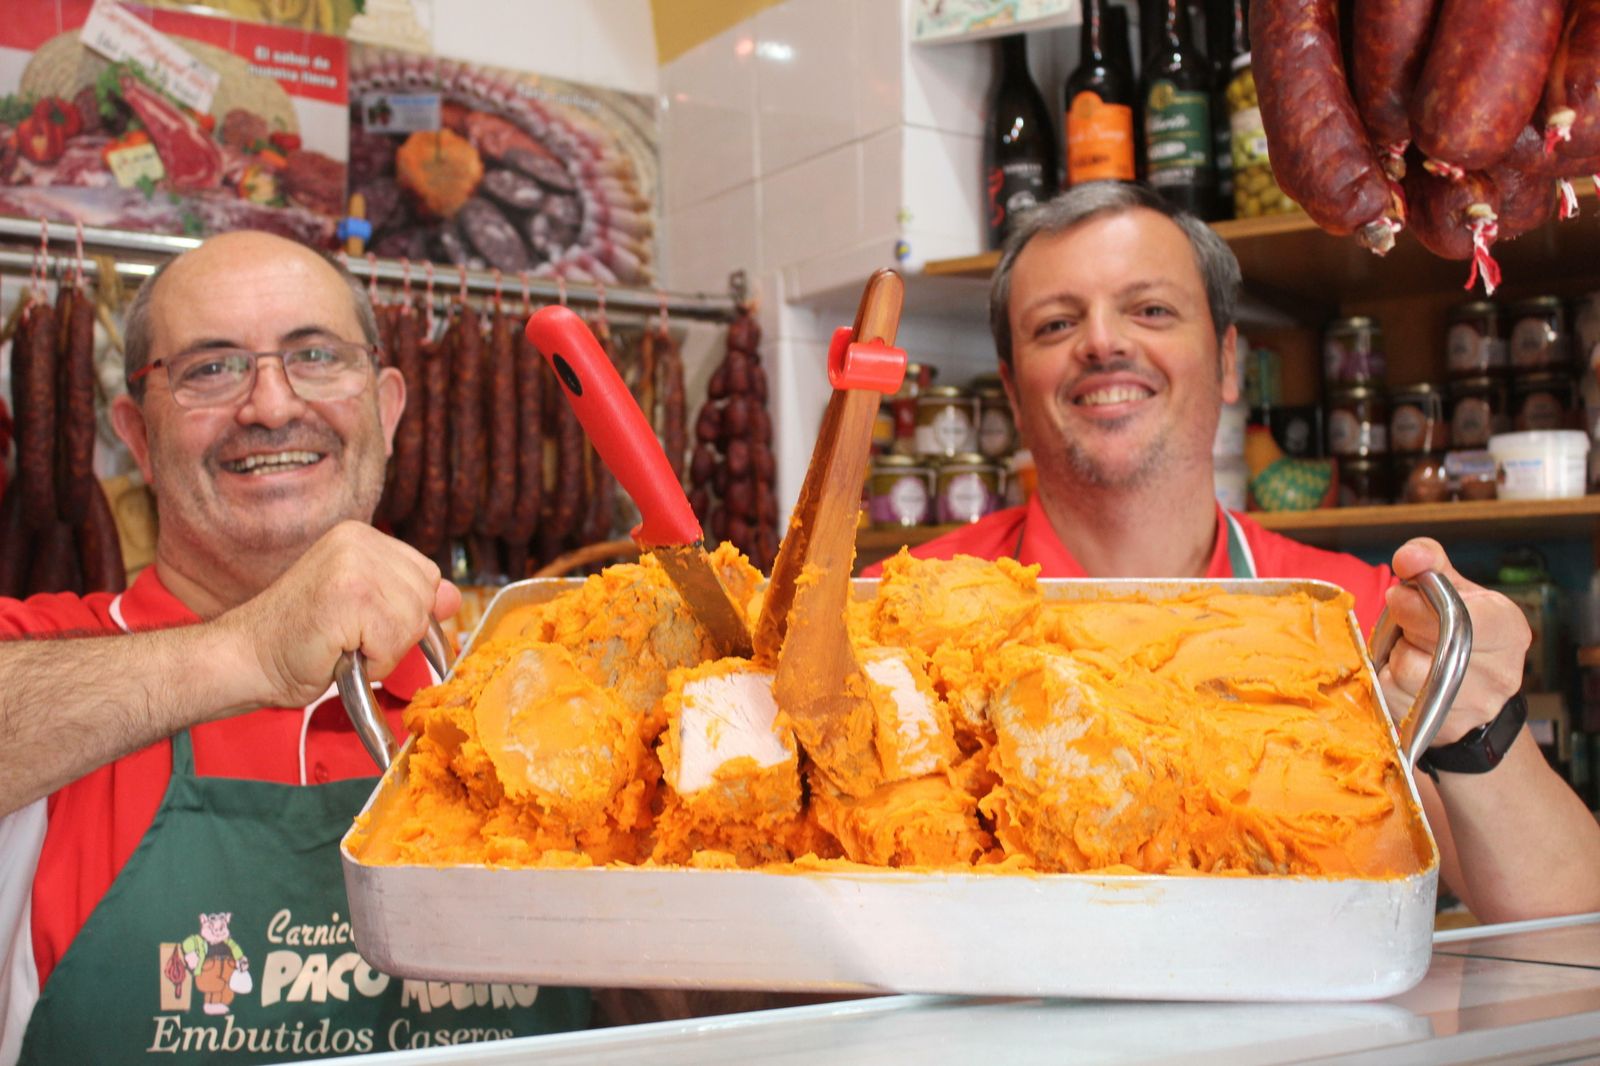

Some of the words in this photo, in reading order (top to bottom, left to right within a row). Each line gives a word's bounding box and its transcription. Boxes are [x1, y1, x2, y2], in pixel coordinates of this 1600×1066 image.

[267, 908, 355, 946] Carnic
[261, 950, 390, 1008] PACO
[146, 1014, 374, 1054] Embutidos
